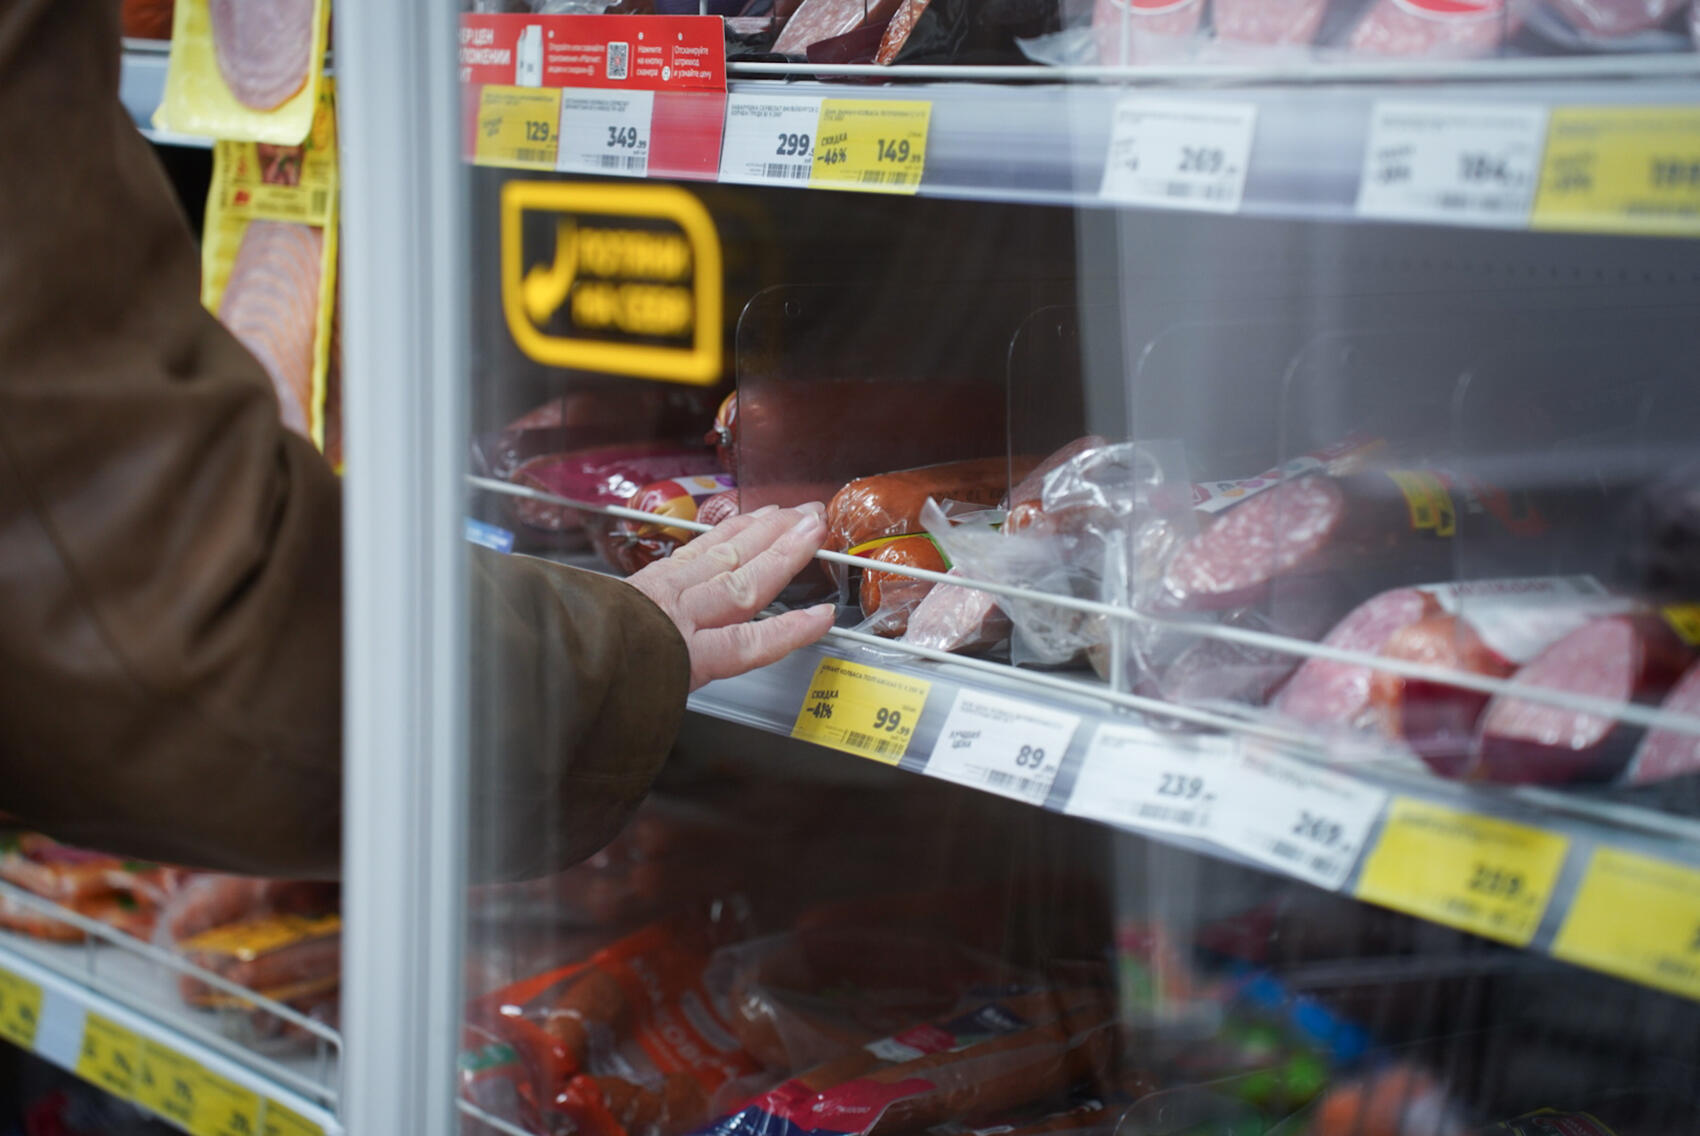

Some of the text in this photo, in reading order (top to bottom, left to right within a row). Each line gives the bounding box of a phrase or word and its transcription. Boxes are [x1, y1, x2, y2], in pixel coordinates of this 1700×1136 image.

[674, 45, 709, 56] Отсканируйте
[821, 132, 848, 146] СКИДКА
[817, 148, 847, 165] -46%
[811, 690, 839, 700] СКИДКА
[806, 703, 834, 719] -41%
